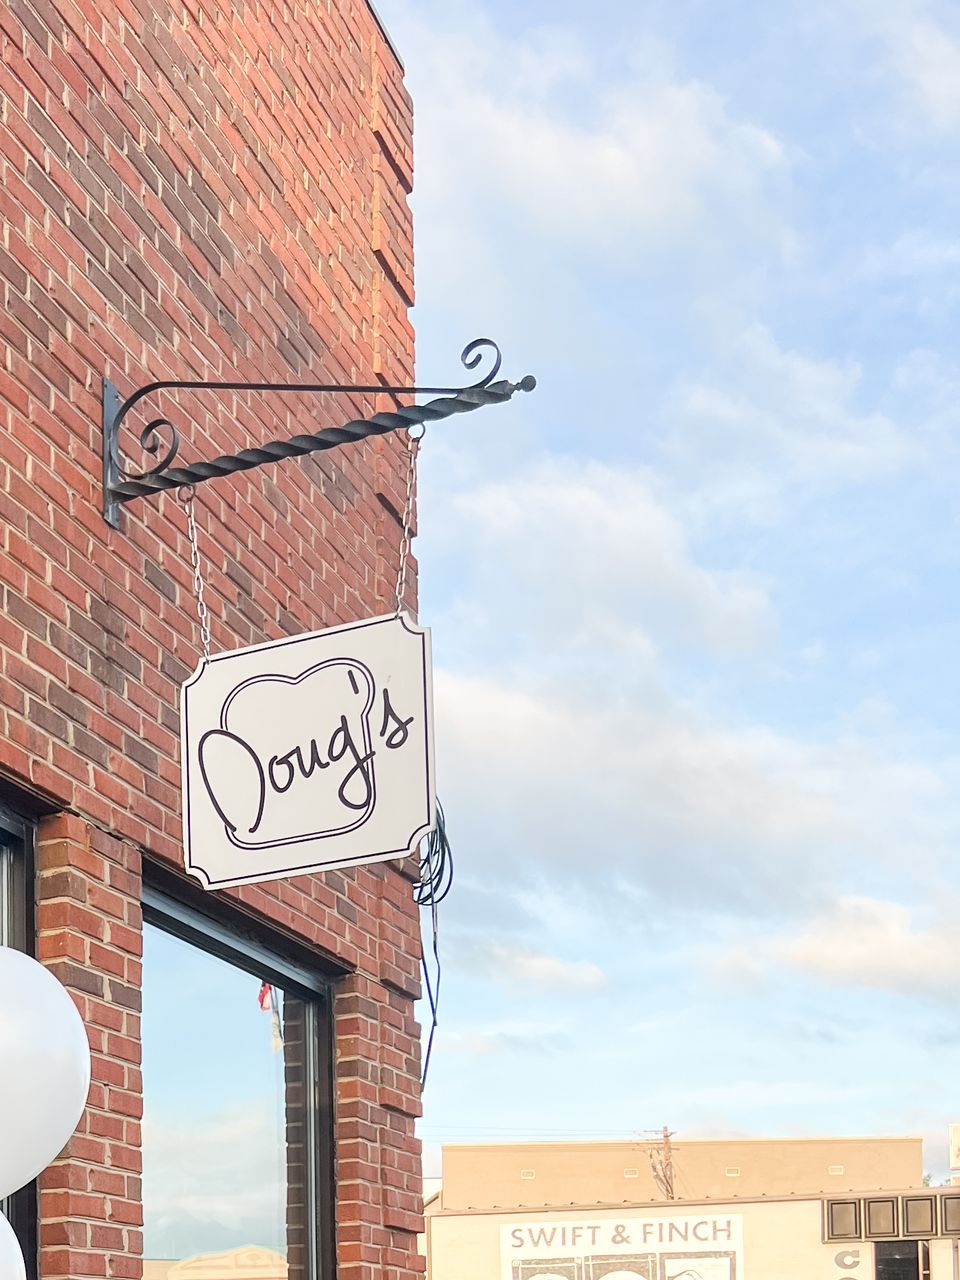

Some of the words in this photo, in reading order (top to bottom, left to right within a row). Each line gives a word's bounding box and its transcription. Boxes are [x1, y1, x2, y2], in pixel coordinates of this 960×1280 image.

[198, 669, 414, 834] Doug's
[511, 1225, 601, 1248] SWIFT
[611, 1224, 632, 1245] &
[642, 1220, 732, 1243] FINCH
